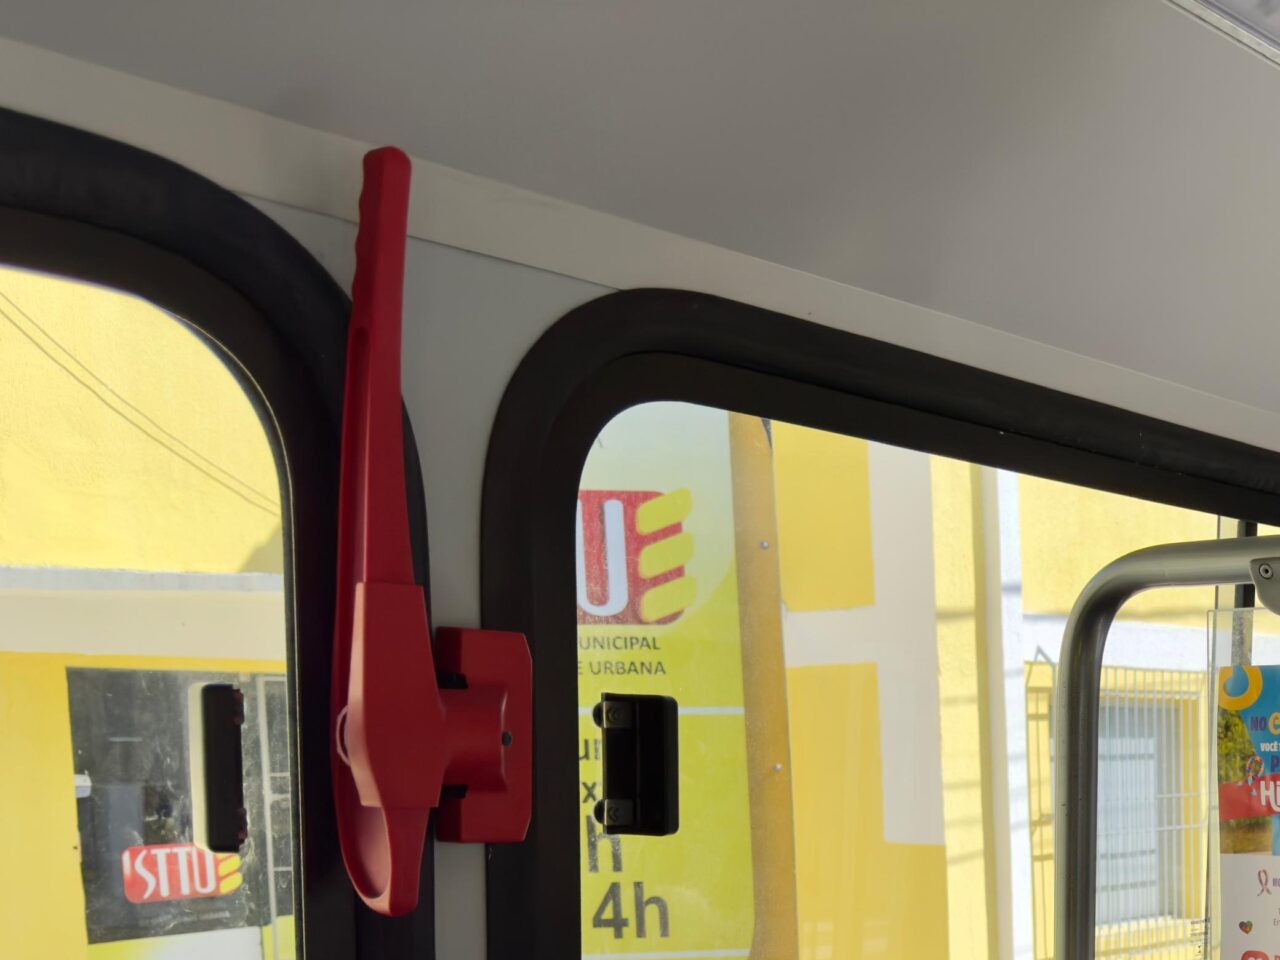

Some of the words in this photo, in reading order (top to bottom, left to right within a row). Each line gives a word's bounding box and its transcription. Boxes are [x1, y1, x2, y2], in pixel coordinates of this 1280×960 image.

[577, 636, 661, 650] UNICIPAL
[589, 661, 667, 675] URBANA
[1250, 717, 1267, 731] NO
[1260, 741, 1278, 752] VOCÊ
